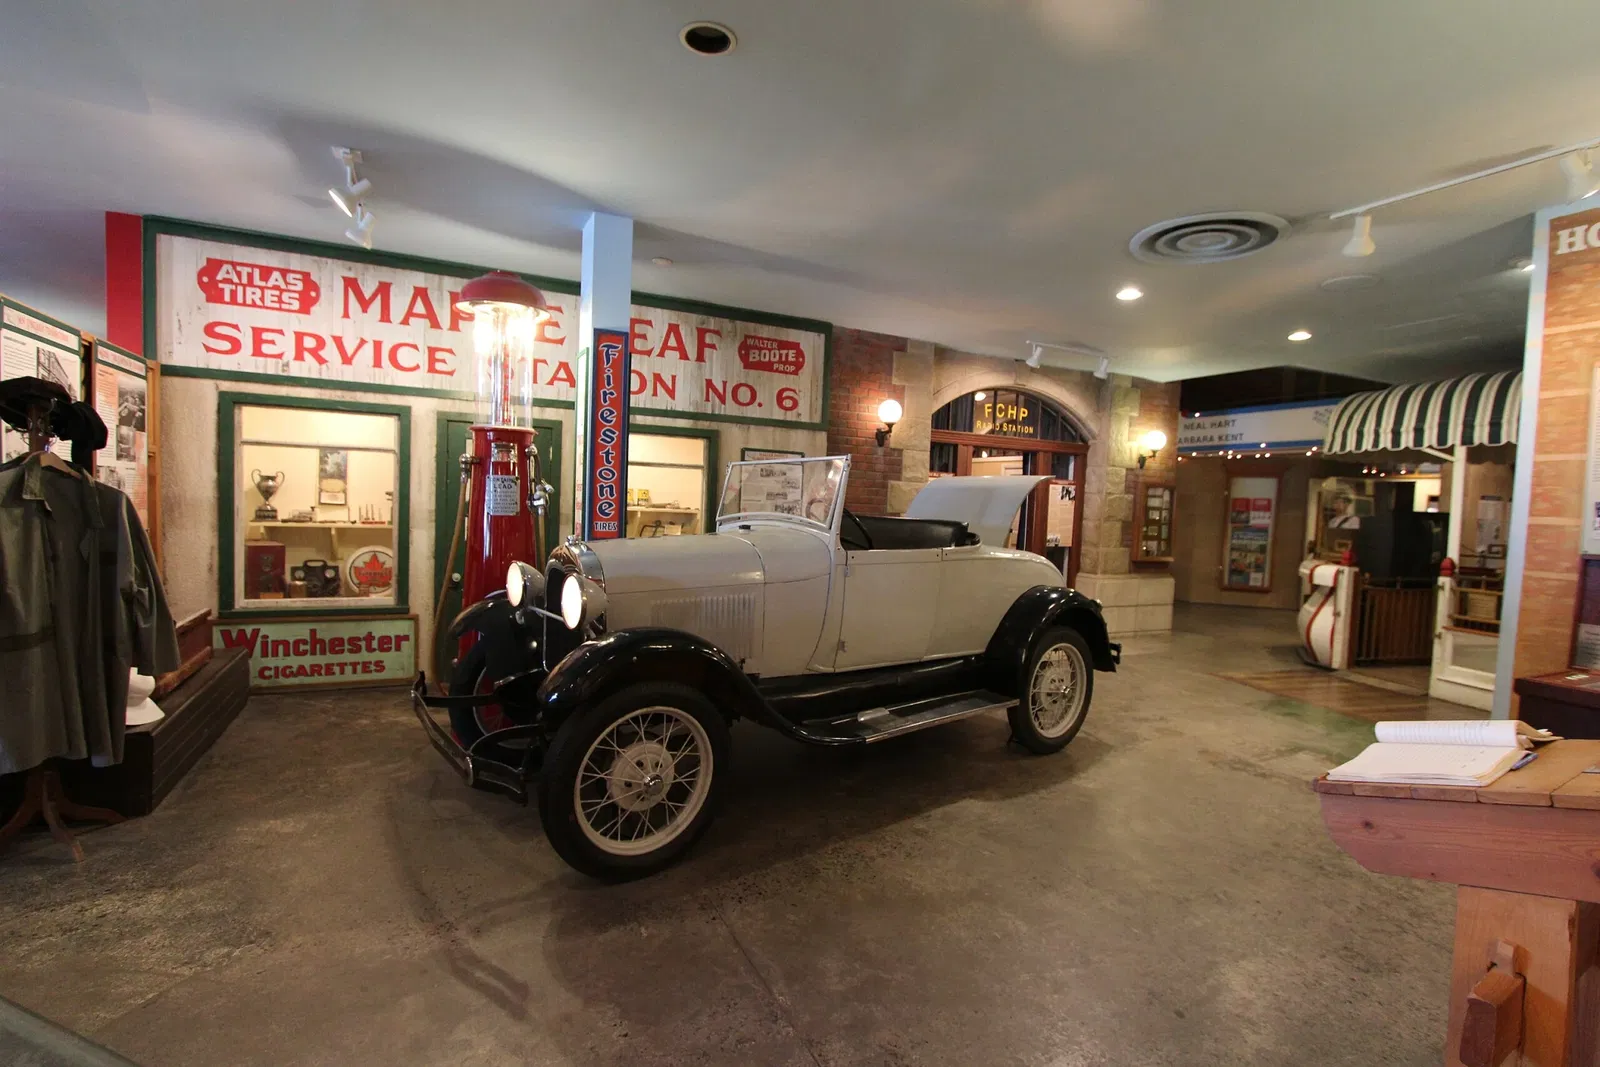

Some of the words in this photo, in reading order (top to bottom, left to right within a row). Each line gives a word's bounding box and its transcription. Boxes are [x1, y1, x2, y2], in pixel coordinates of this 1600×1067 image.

[216, 264, 304, 291] ATLAS
[218, 282, 300, 311] TIRES
[630, 317, 722, 364] EAF
[746, 338, 778, 349] WALTER
[749, 349, 797, 362] BOOTE
[202, 320, 456, 377] SERVICE
[705, 379, 763, 408] NO.
[776, 387, 799, 412] 6
[773, 363, 796, 372] PROP
[984, 403, 1029, 422] FCHP
[597, 342, 622, 518] Firestone
[1183, 421, 1207, 431] NEAL
[1210, 419, 1237, 429] HART
[1178, 435, 1215, 445] ARBARA
[1217, 433, 1245, 442] KENT
[594, 521, 618, 531] TIRES
[220, 628, 410, 659] Winchester
[257, 660, 386, 680] CIGARETTES
